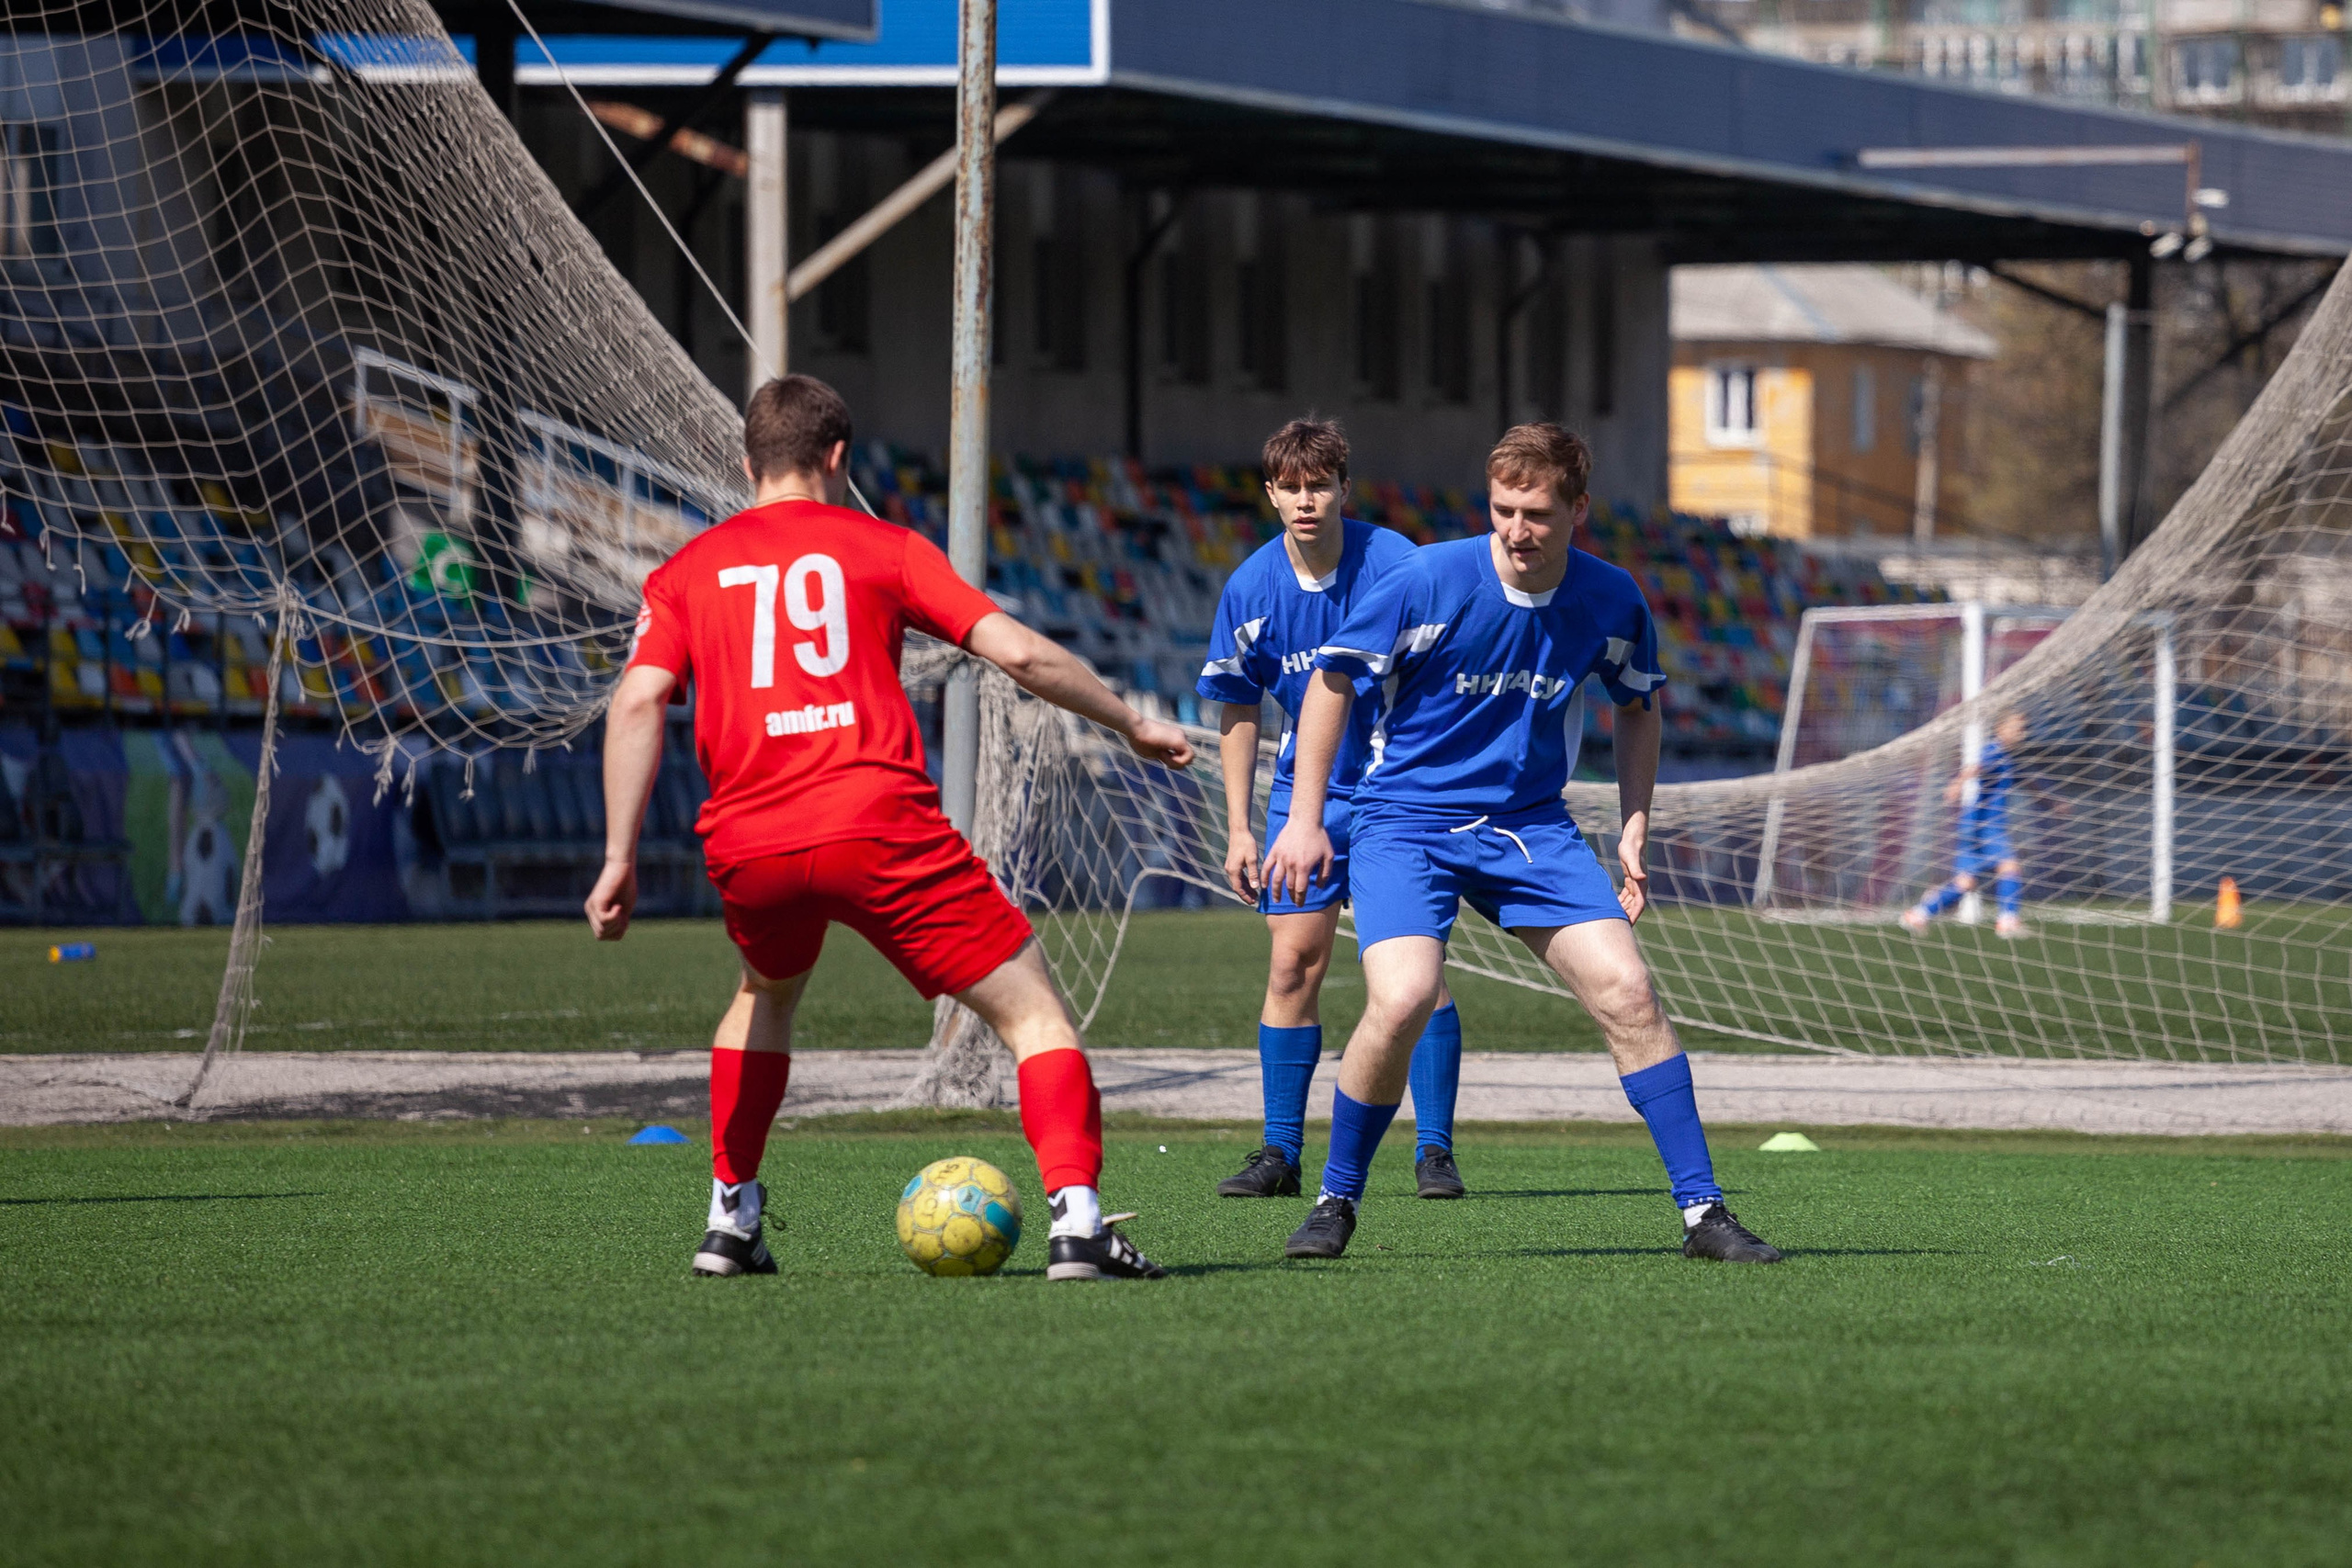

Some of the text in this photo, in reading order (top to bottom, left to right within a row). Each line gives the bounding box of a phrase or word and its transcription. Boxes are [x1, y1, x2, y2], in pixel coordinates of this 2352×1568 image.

[718, 553, 850, 688] 79
[1455, 670, 1566, 700] ННГАСУ
[764, 701, 855, 737] amfr.ru
